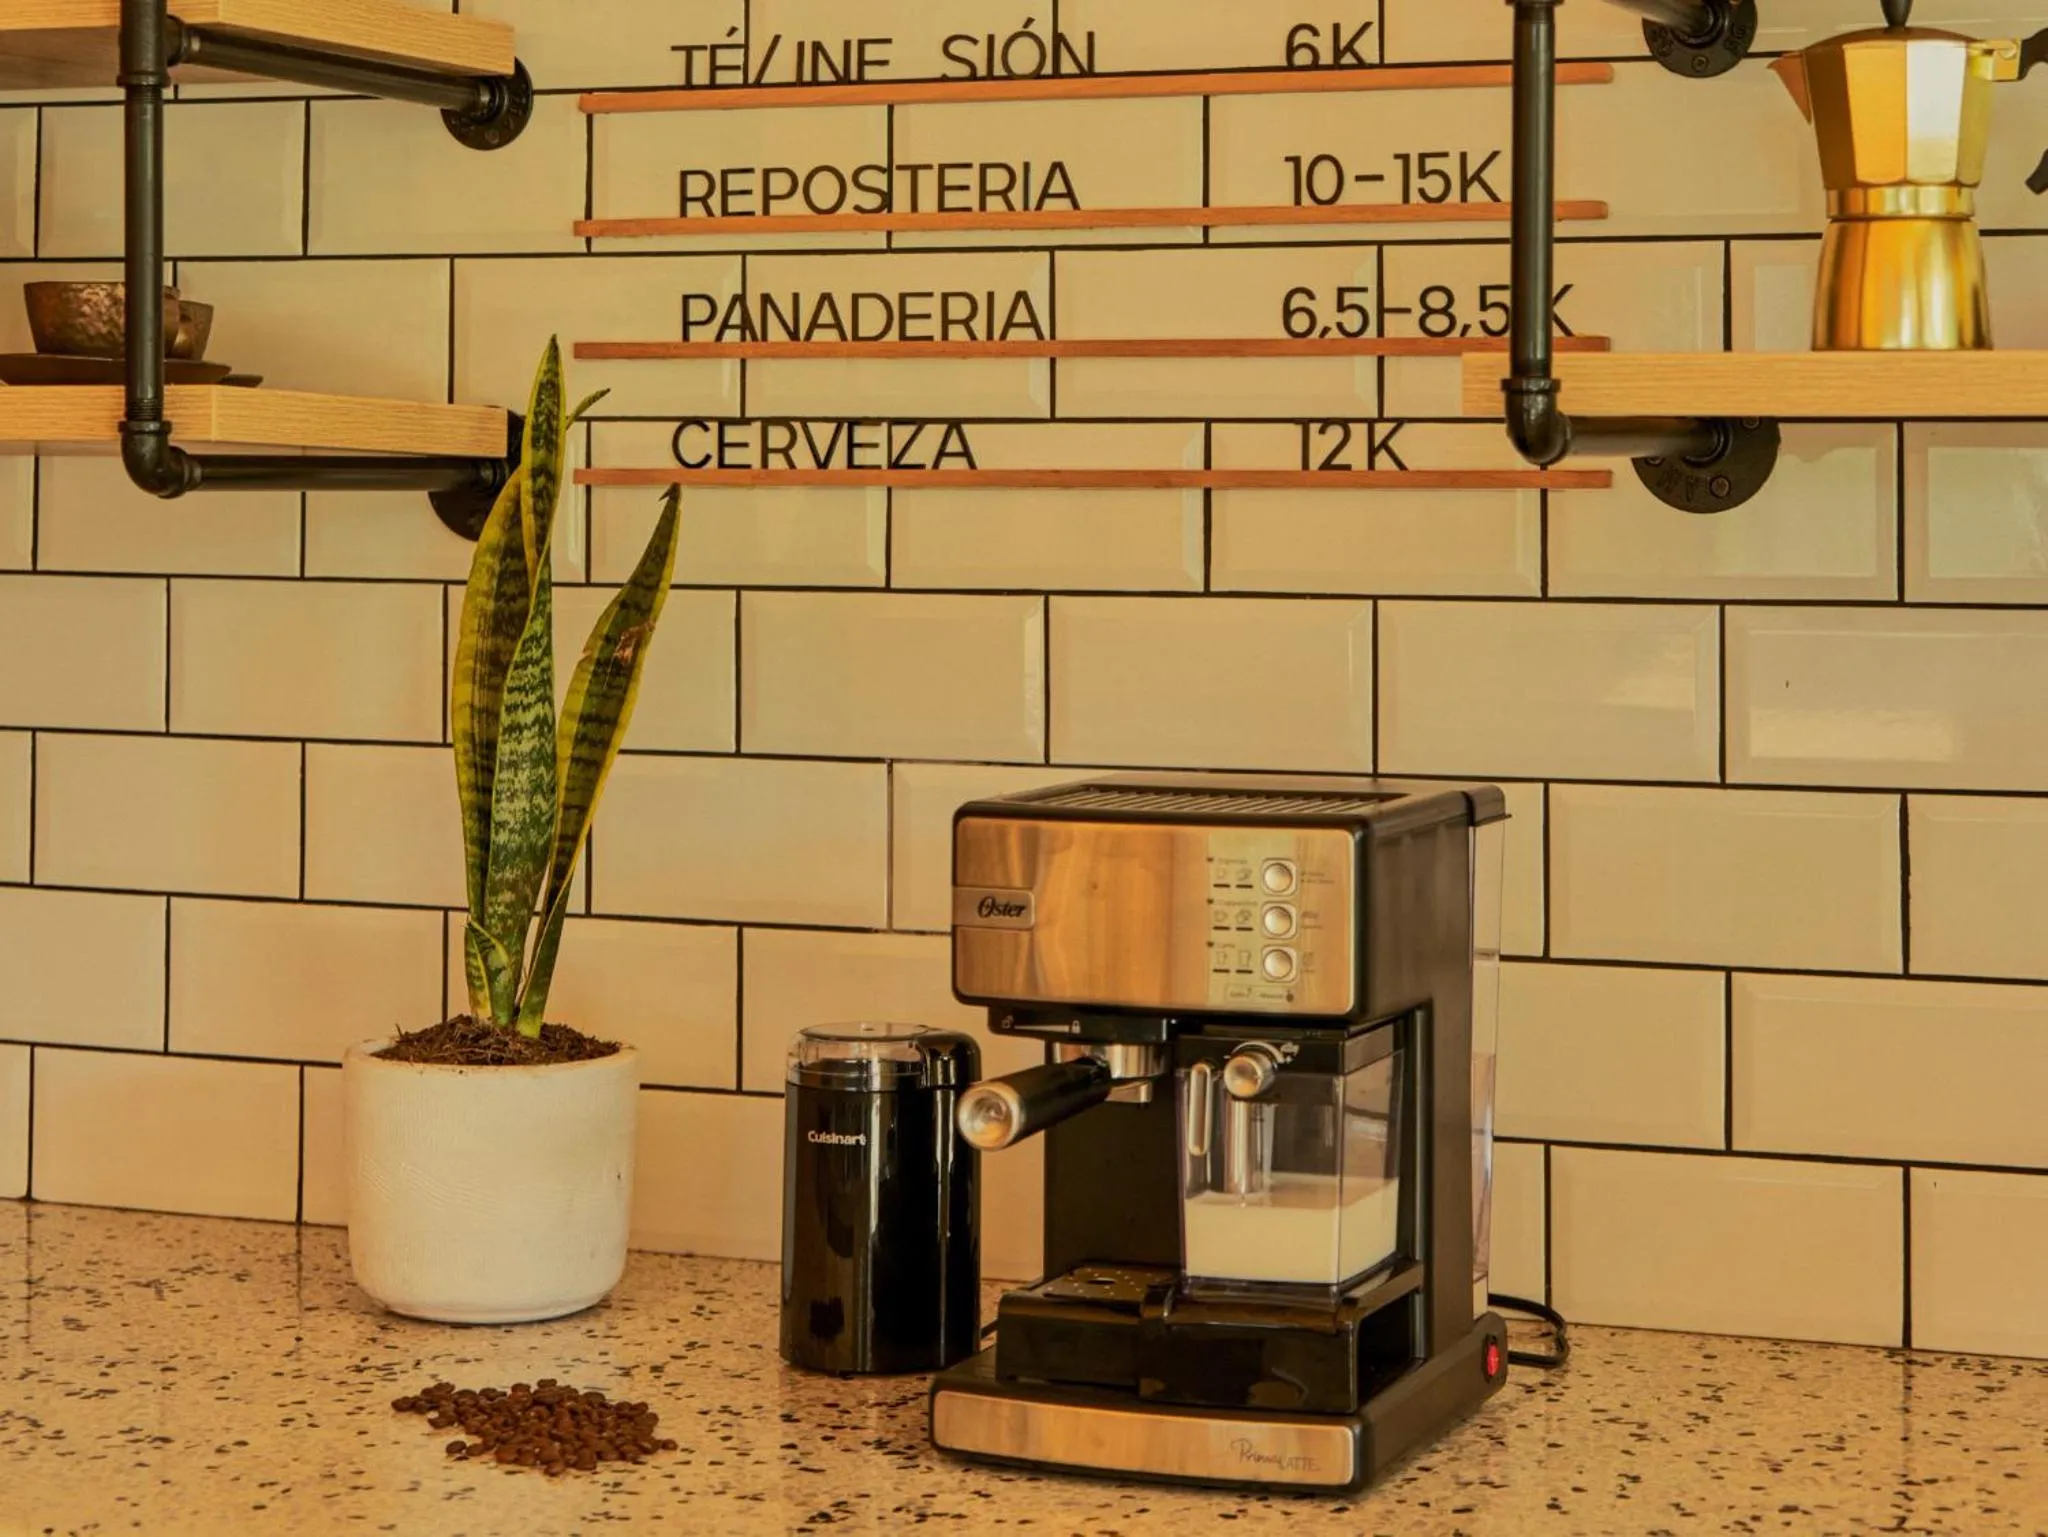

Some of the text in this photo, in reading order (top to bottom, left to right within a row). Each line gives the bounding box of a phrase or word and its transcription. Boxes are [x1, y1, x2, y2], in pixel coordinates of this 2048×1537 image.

[940, 17, 1095, 79] SIÓN
[1285, 21, 1374, 68] 6K
[678, 161, 1082, 218] REPOSTERIA
[1284, 150, 1502, 206] 10-15K
[681, 290, 1045, 342] PANADERIA
[671, 419, 978, 470] CERVEZA
[1295, 420, 1409, 471] 12K
[977, 895, 1026, 918] Oster
[807, 1130, 867, 1146] Cuisinart
